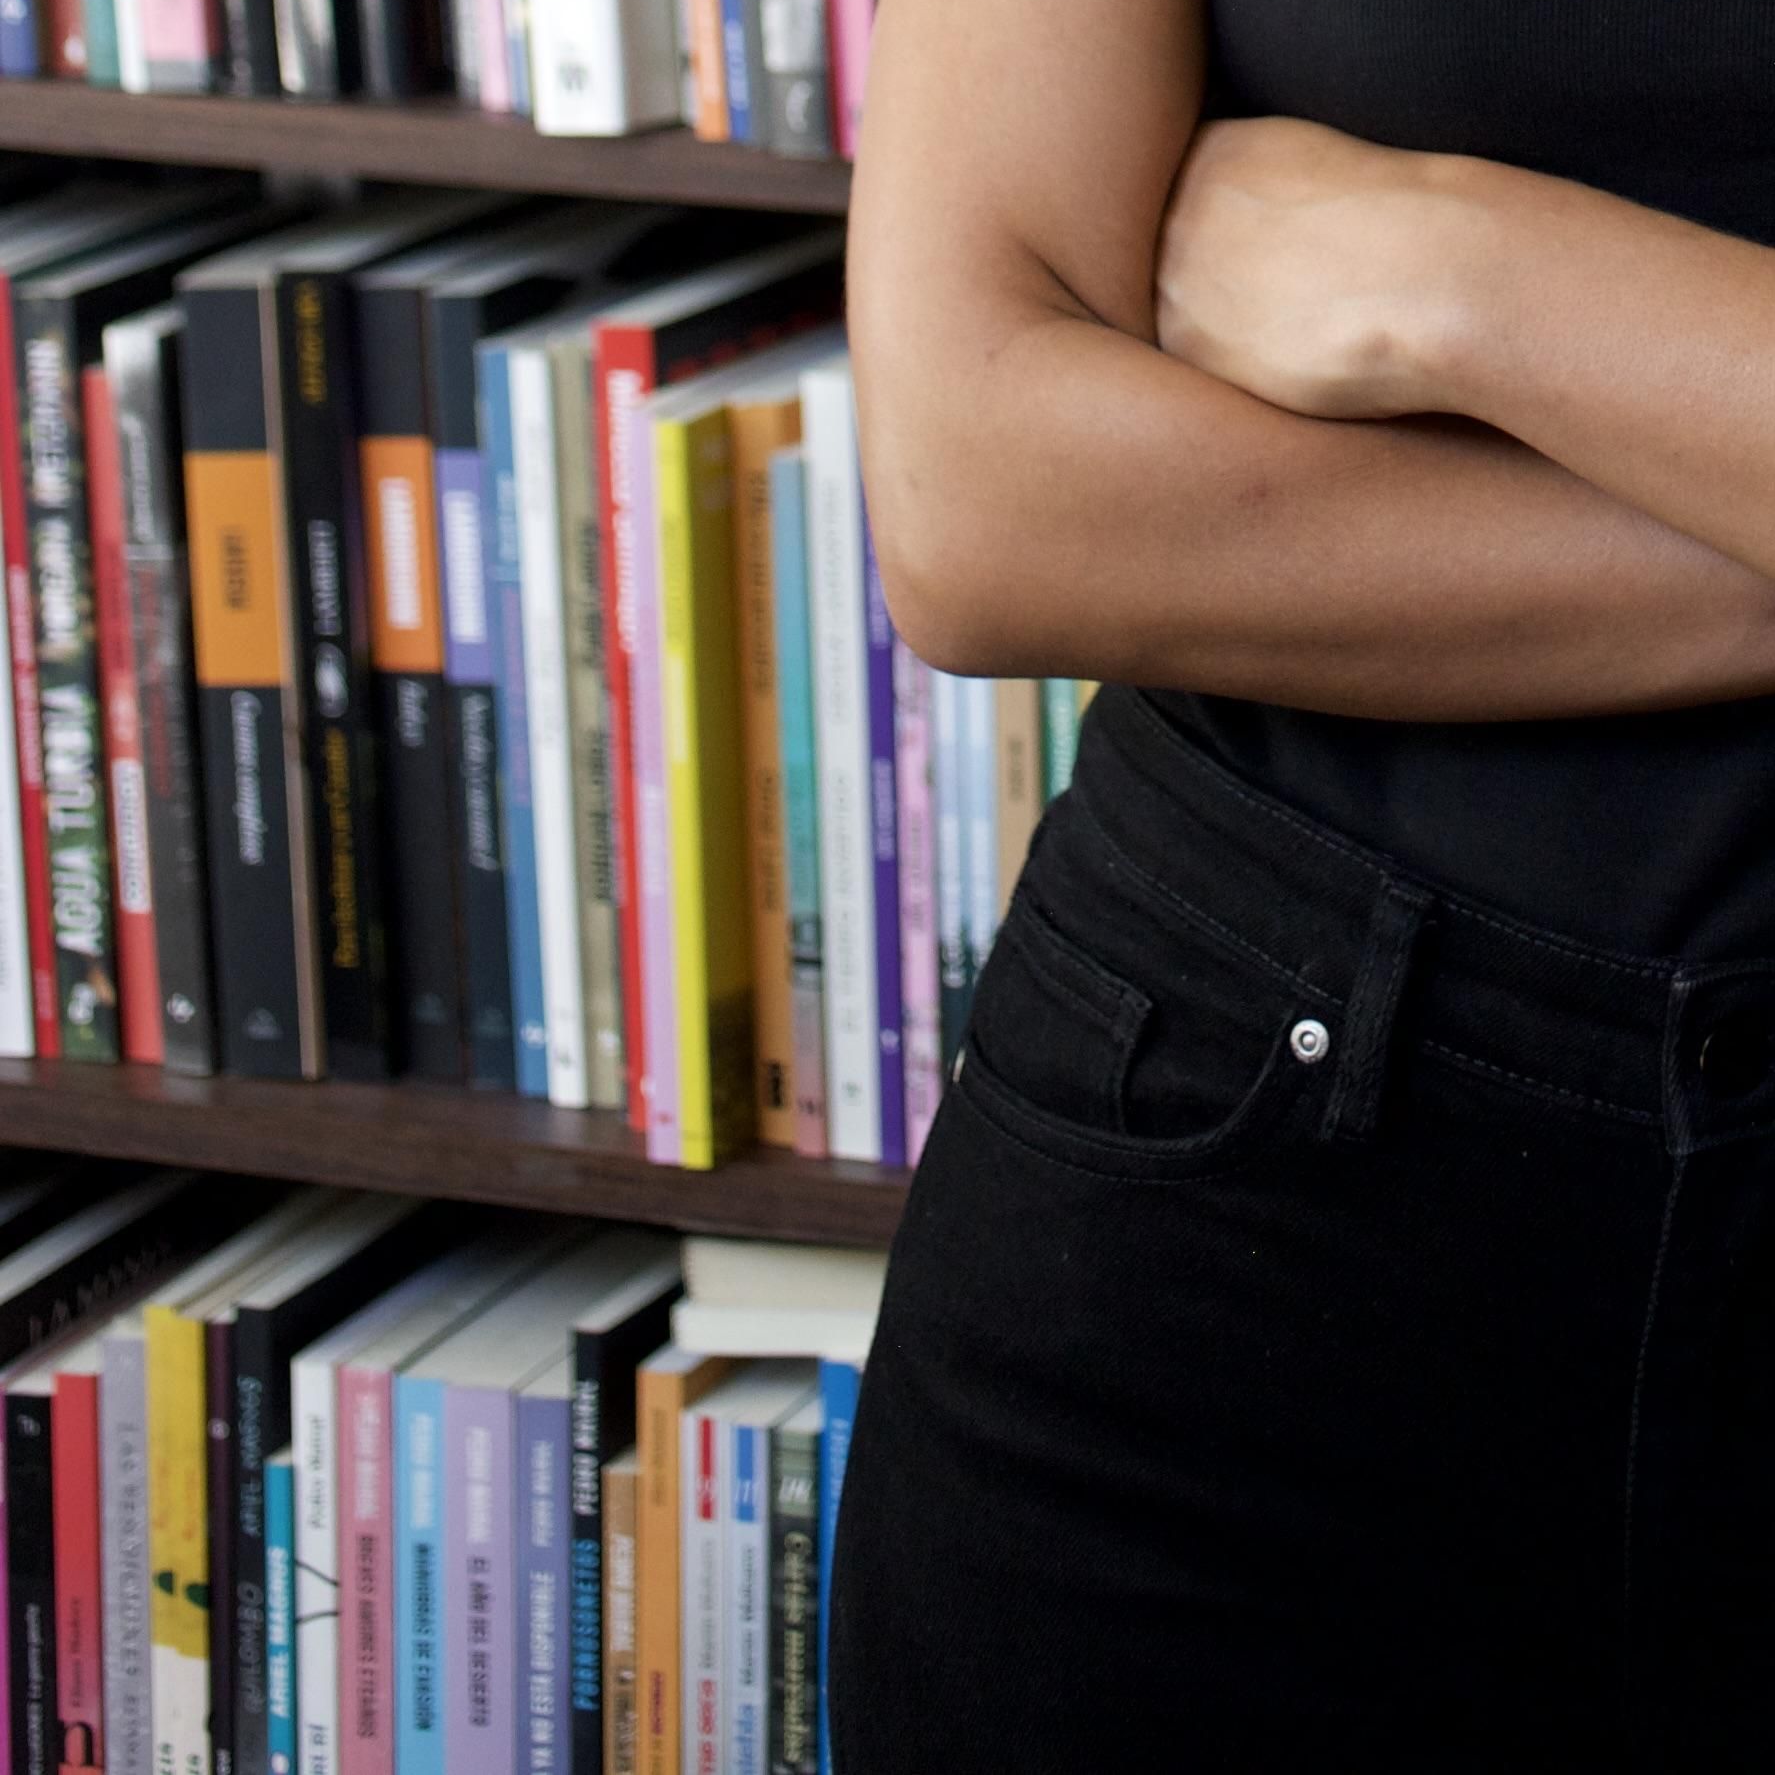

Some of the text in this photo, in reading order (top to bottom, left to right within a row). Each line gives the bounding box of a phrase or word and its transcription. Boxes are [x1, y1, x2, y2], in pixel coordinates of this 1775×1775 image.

[50, 841, 104, 956] AGUA
[572, 1452, 597, 1515] PEDRO
[268, 1546, 289, 1718] ARIEL MAGNUS
[530, 1571, 555, 1670] DISPONIBLE
[572, 1538, 600, 1711] PORNOSONETOS
